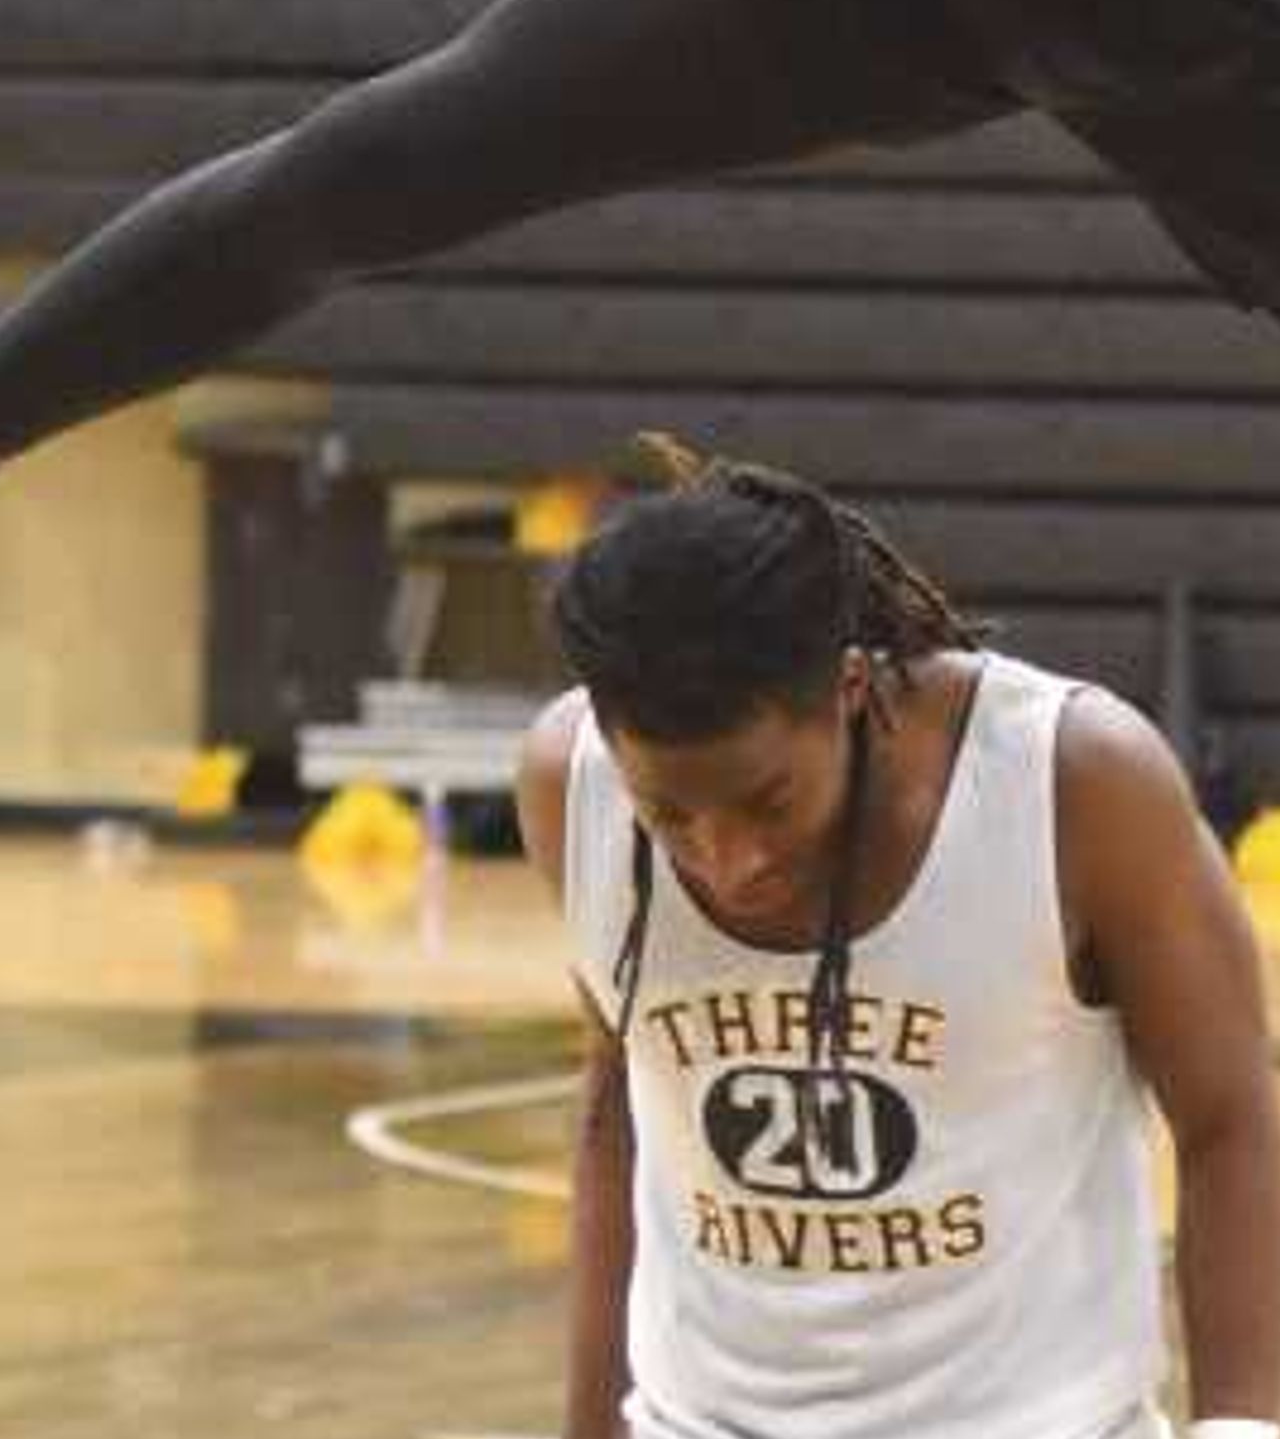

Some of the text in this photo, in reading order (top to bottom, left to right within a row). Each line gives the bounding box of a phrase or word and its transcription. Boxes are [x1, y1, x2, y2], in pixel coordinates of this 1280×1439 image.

[647, 990, 946, 1068] THREE
[728, 1071, 879, 1191] 20
[693, 1192, 986, 1273] RIVERS
